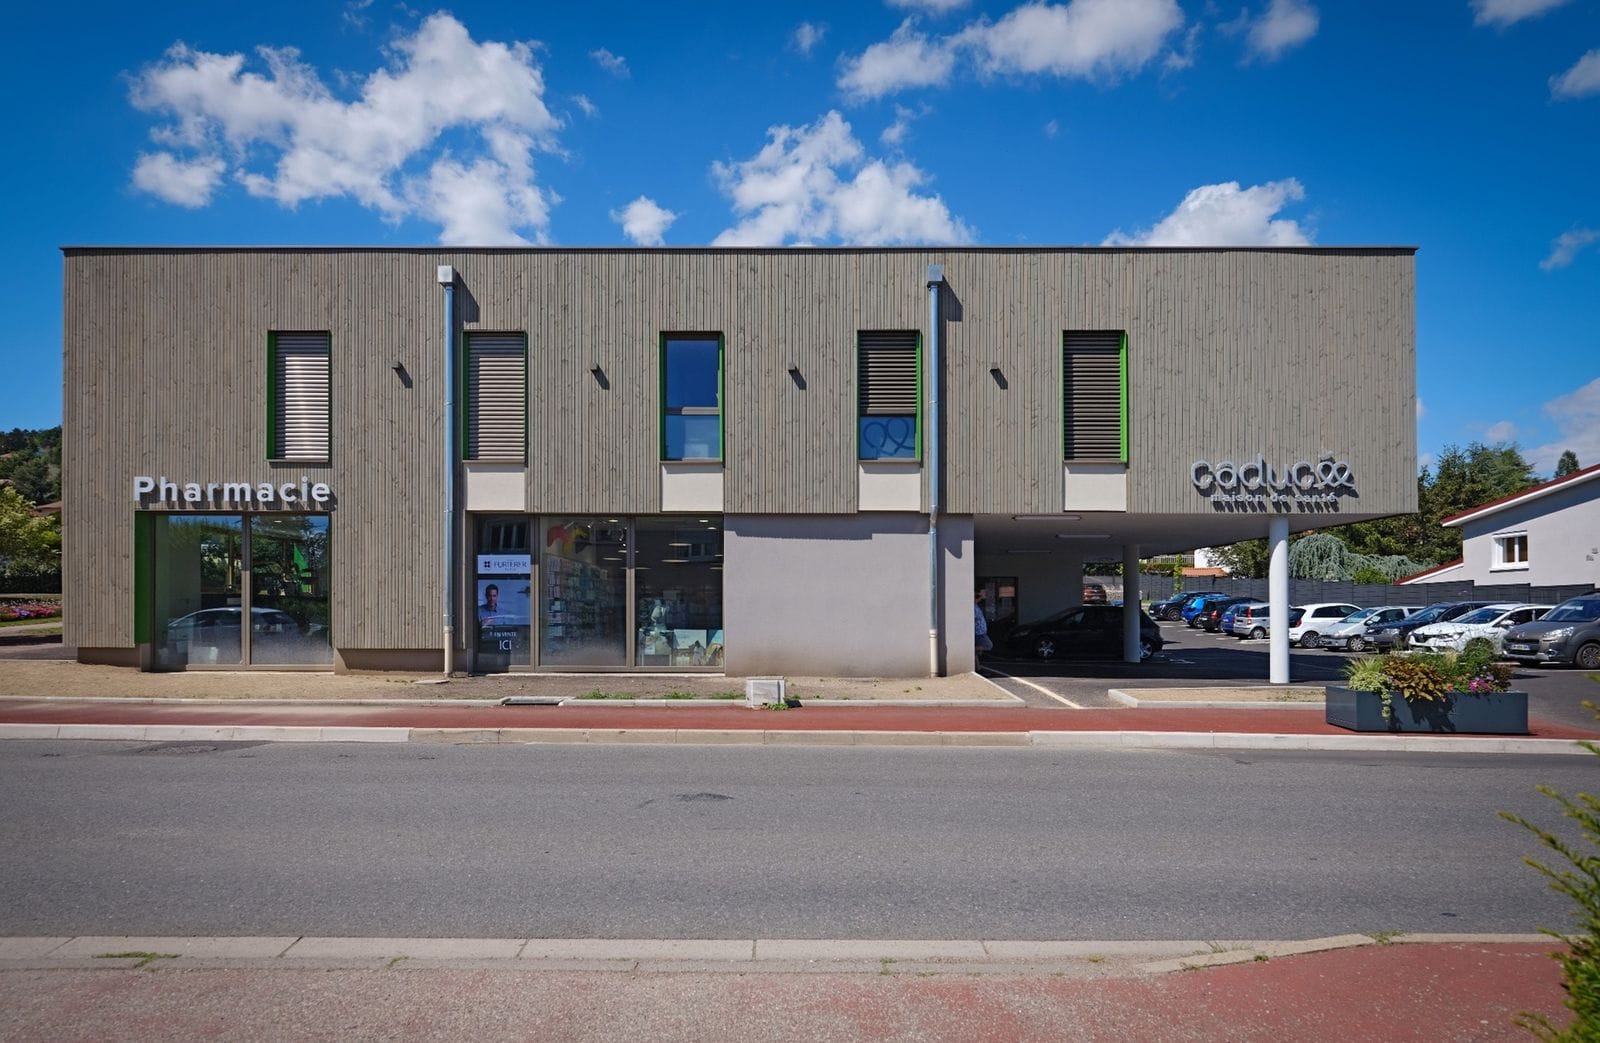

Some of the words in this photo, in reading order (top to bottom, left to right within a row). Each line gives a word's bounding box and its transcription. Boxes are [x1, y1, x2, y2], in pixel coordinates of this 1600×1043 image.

[134, 476, 330, 502] Pharmacie
[1210, 491, 1263, 502] maison
[1270, 492, 1287, 502] de
[1295, 491, 1337, 502] santé
[499, 639, 512, 651] ICI
